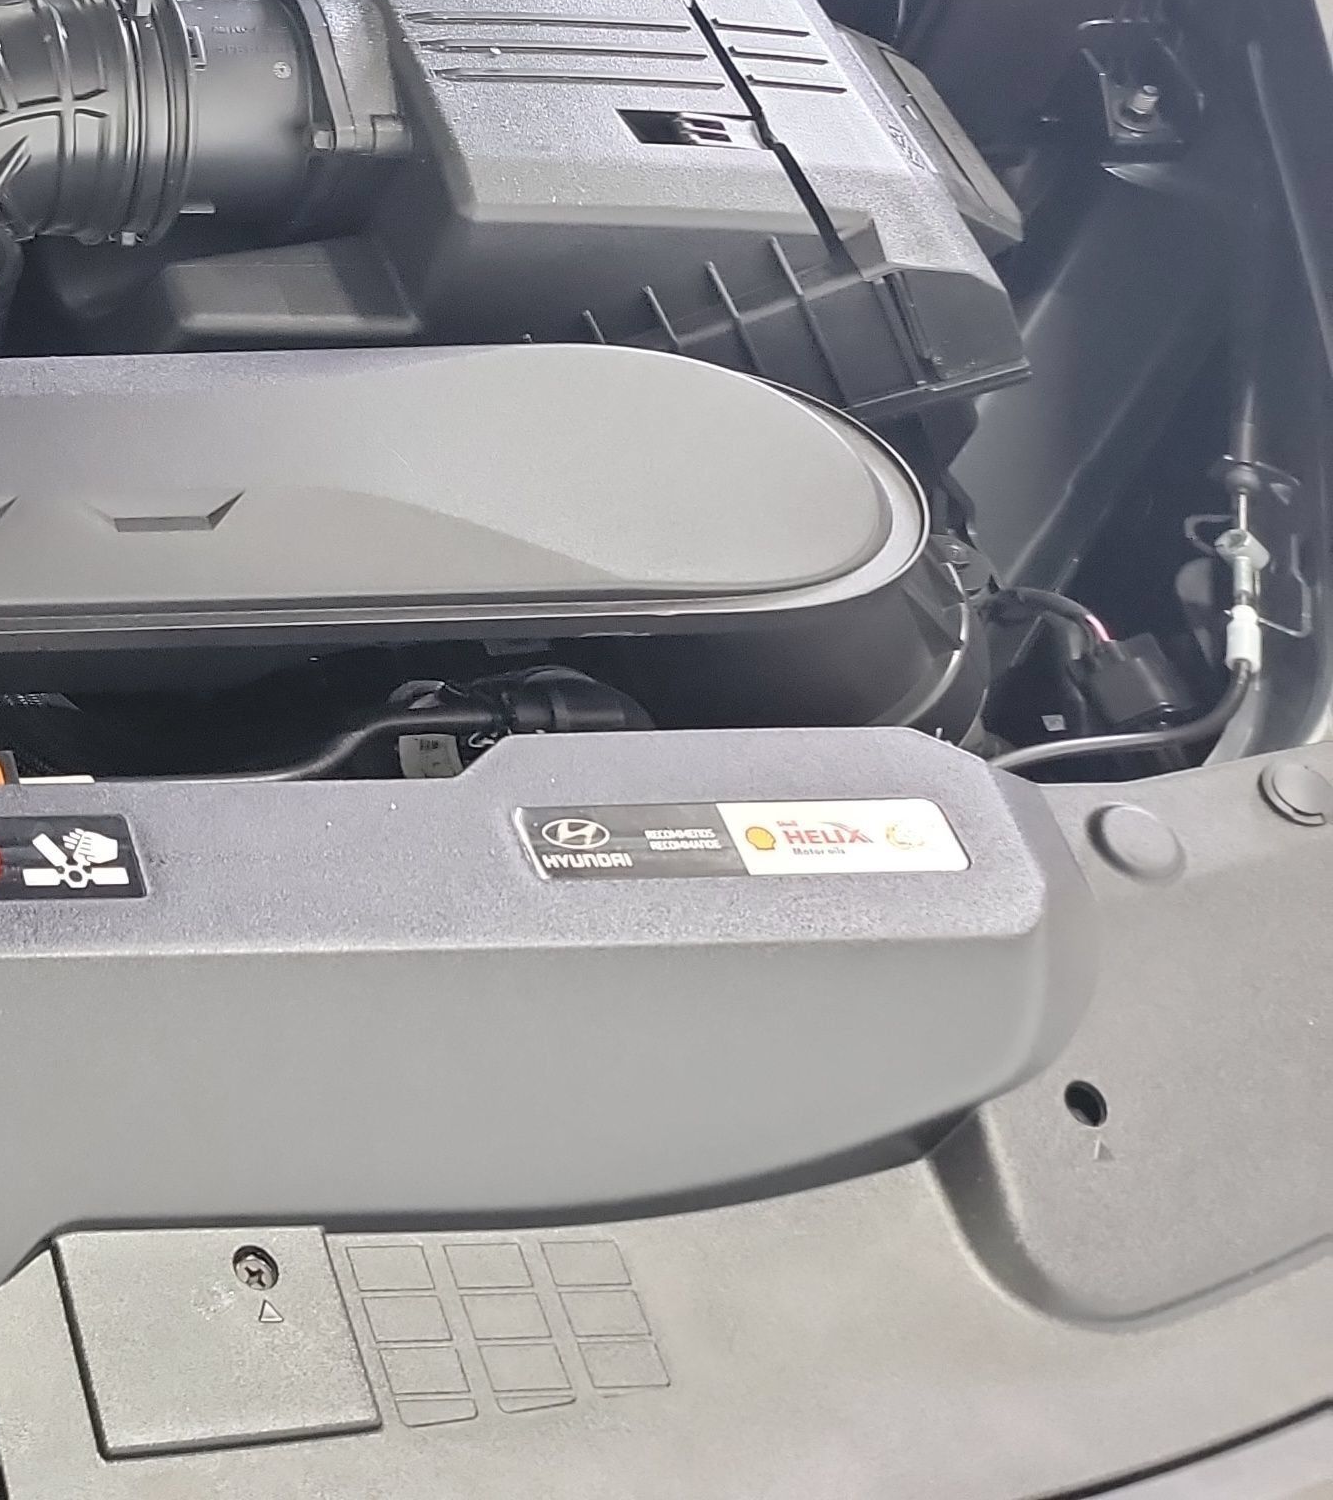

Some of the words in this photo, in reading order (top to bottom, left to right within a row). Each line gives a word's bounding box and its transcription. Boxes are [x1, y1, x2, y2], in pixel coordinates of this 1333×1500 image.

[644, 828, 716, 840] RECOMMENDS
[782, 829, 869, 845] HELIX
[649, 839, 722, 851] RECOMMANDE
[792, 847, 825, 856] Motor
[827, 846, 846, 855] oils
[542, 852, 633, 869] HYUNDAI
